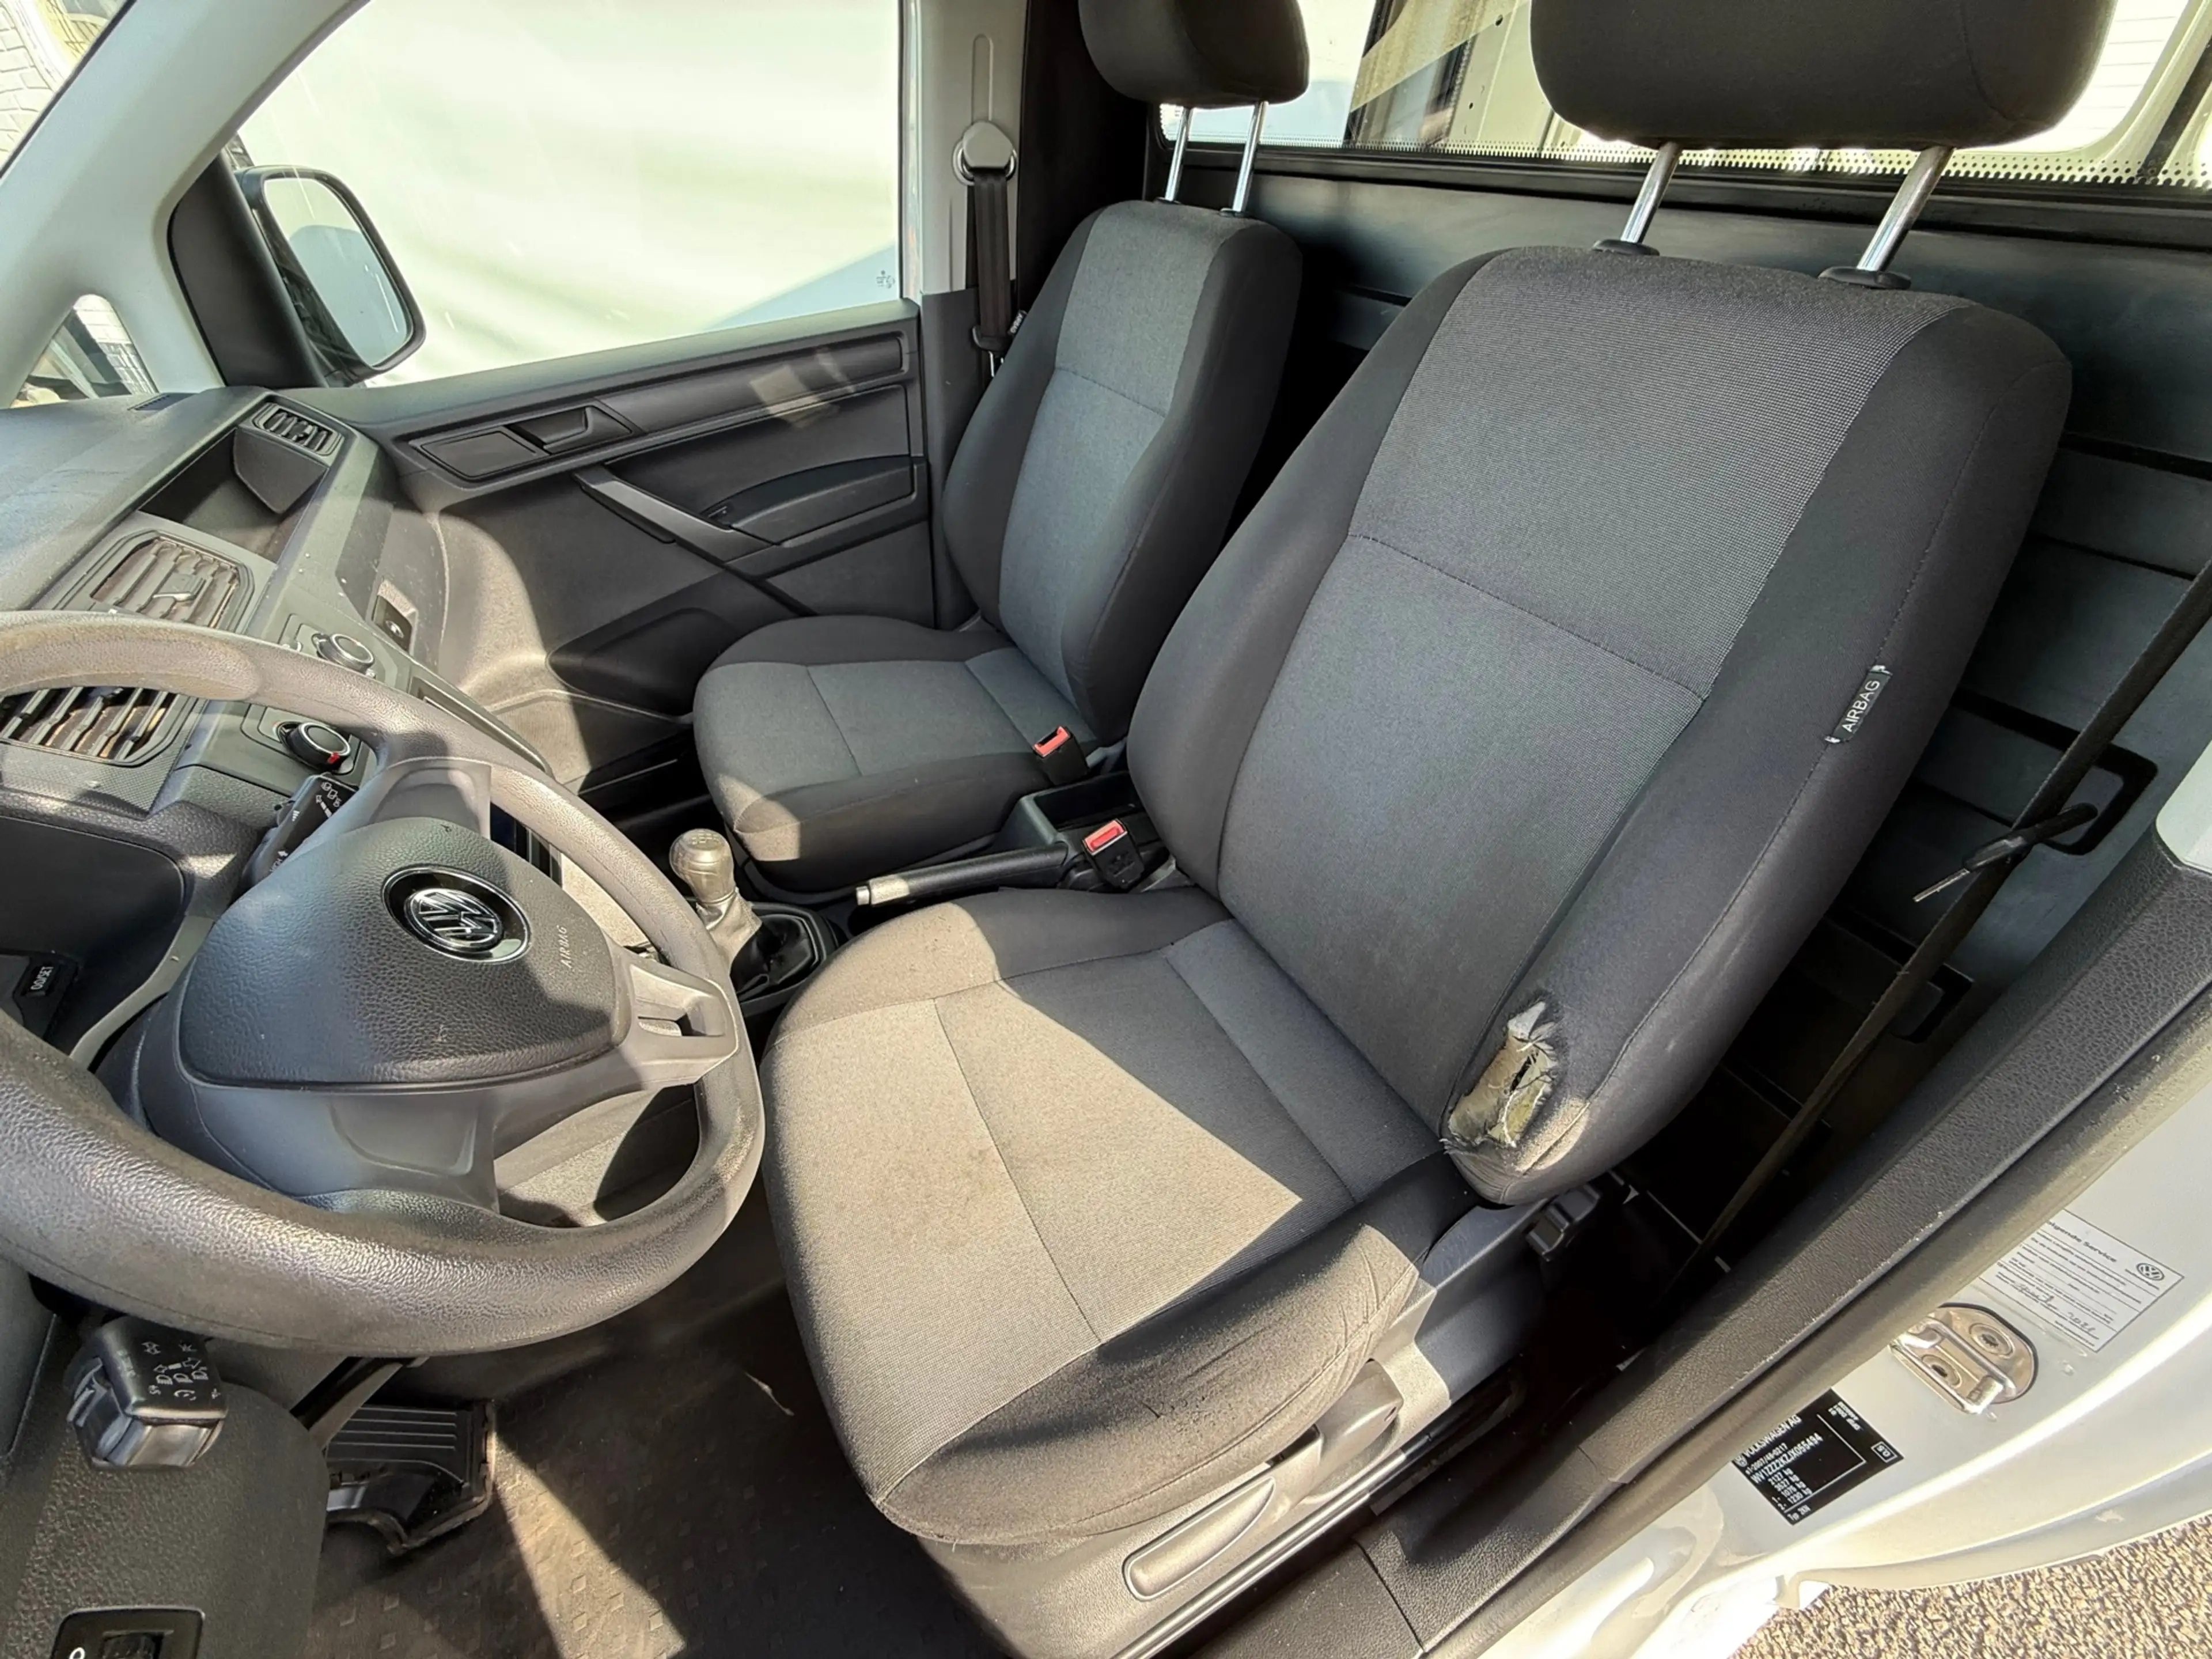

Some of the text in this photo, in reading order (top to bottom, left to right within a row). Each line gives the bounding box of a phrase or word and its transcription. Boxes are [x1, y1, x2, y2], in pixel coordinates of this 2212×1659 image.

[1842, 680, 1880, 732] AIRBAG
[557, 925, 572, 968] AIRBAG
[2083, 1241, 2117, 1262] Service
[1744, 1421, 1791, 1458] VOLKSWAGEN
[1787, 1414, 1802, 1428] AG
[1782, 1467, 1794, 1476] kg
[1788, 1474, 1800, 1483] kg
[1794, 1481, 1806, 1489] kg
[1801, 1487, 1813, 1496] kg
